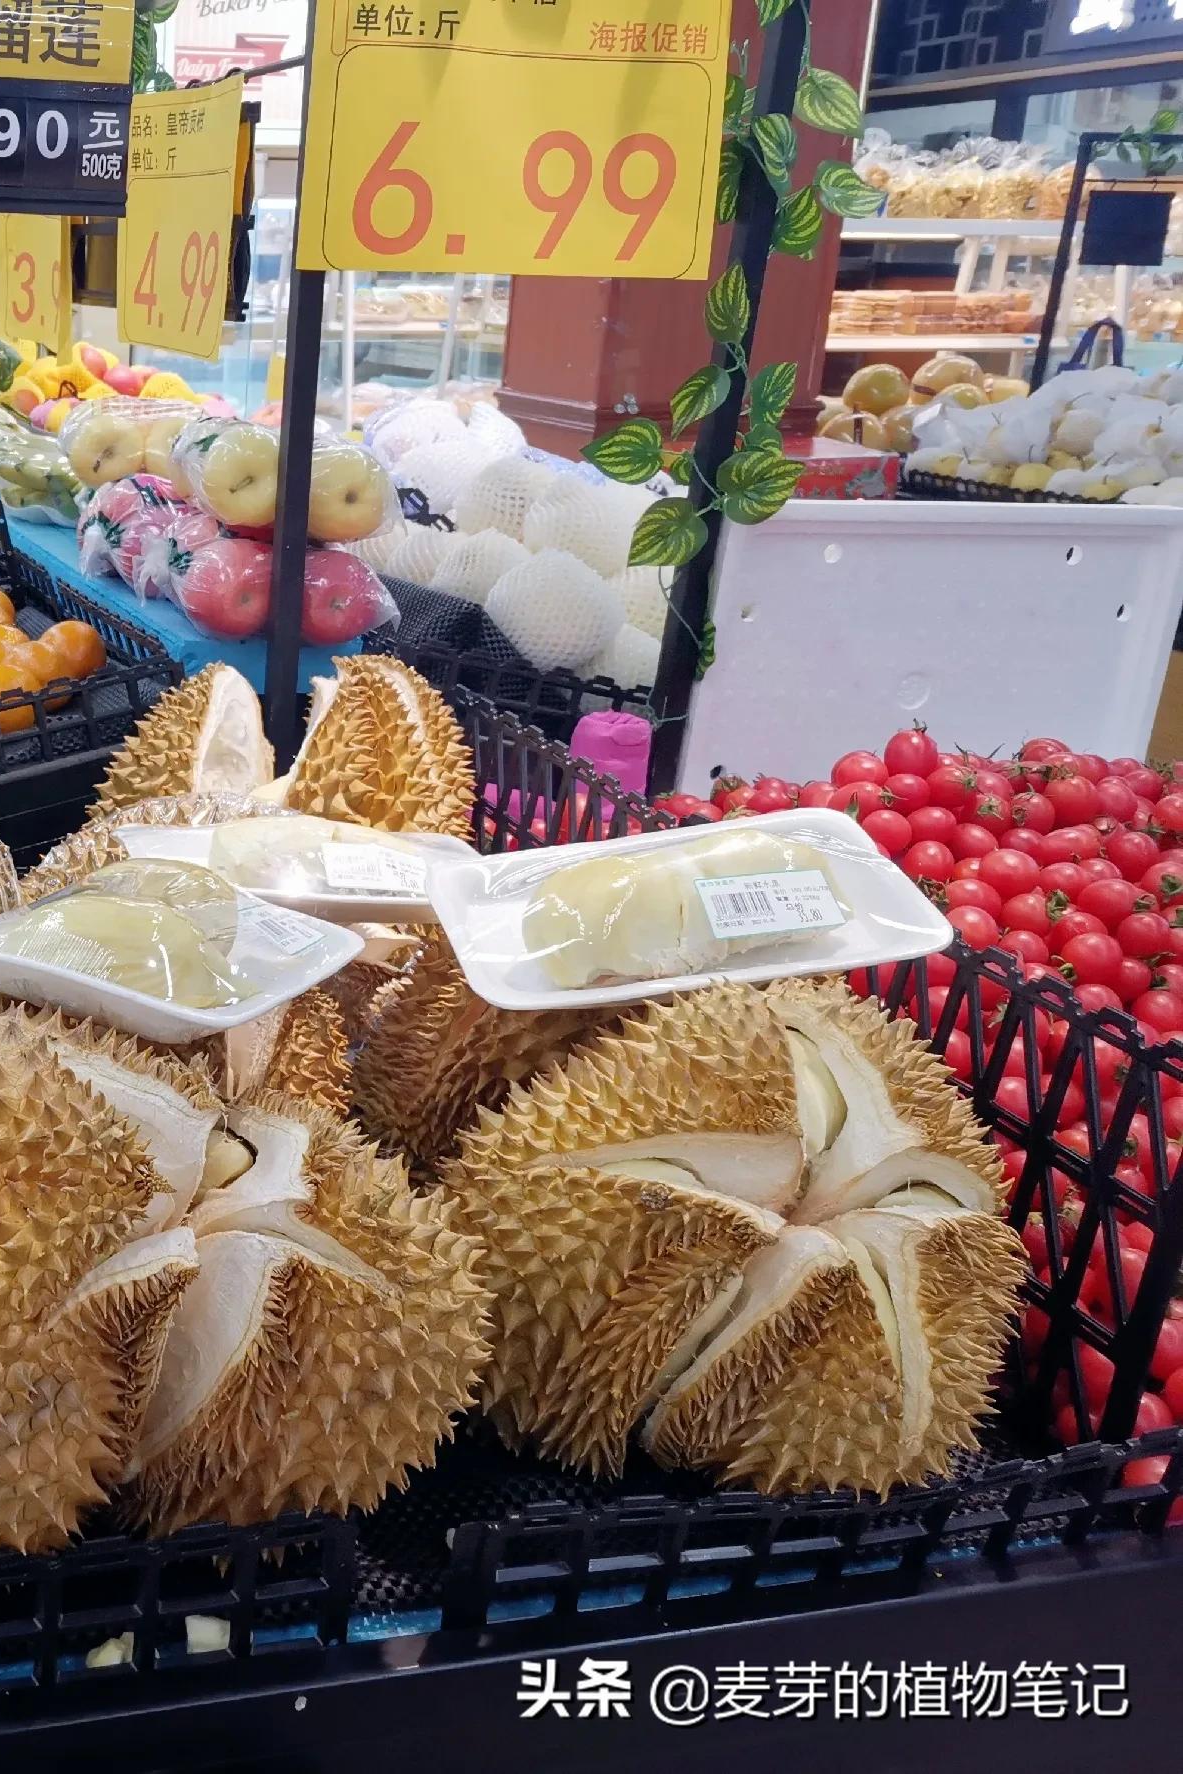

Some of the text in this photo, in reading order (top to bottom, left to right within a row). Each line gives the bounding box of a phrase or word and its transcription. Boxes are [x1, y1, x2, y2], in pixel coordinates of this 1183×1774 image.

[588, 20, 709, 55] 海报促销
[89, 111, 120, 138] 元
[82, 152, 122, 181] 500克
[351, 121, 677, 262] 6.99
[133, 231, 219, 336] 4.99
